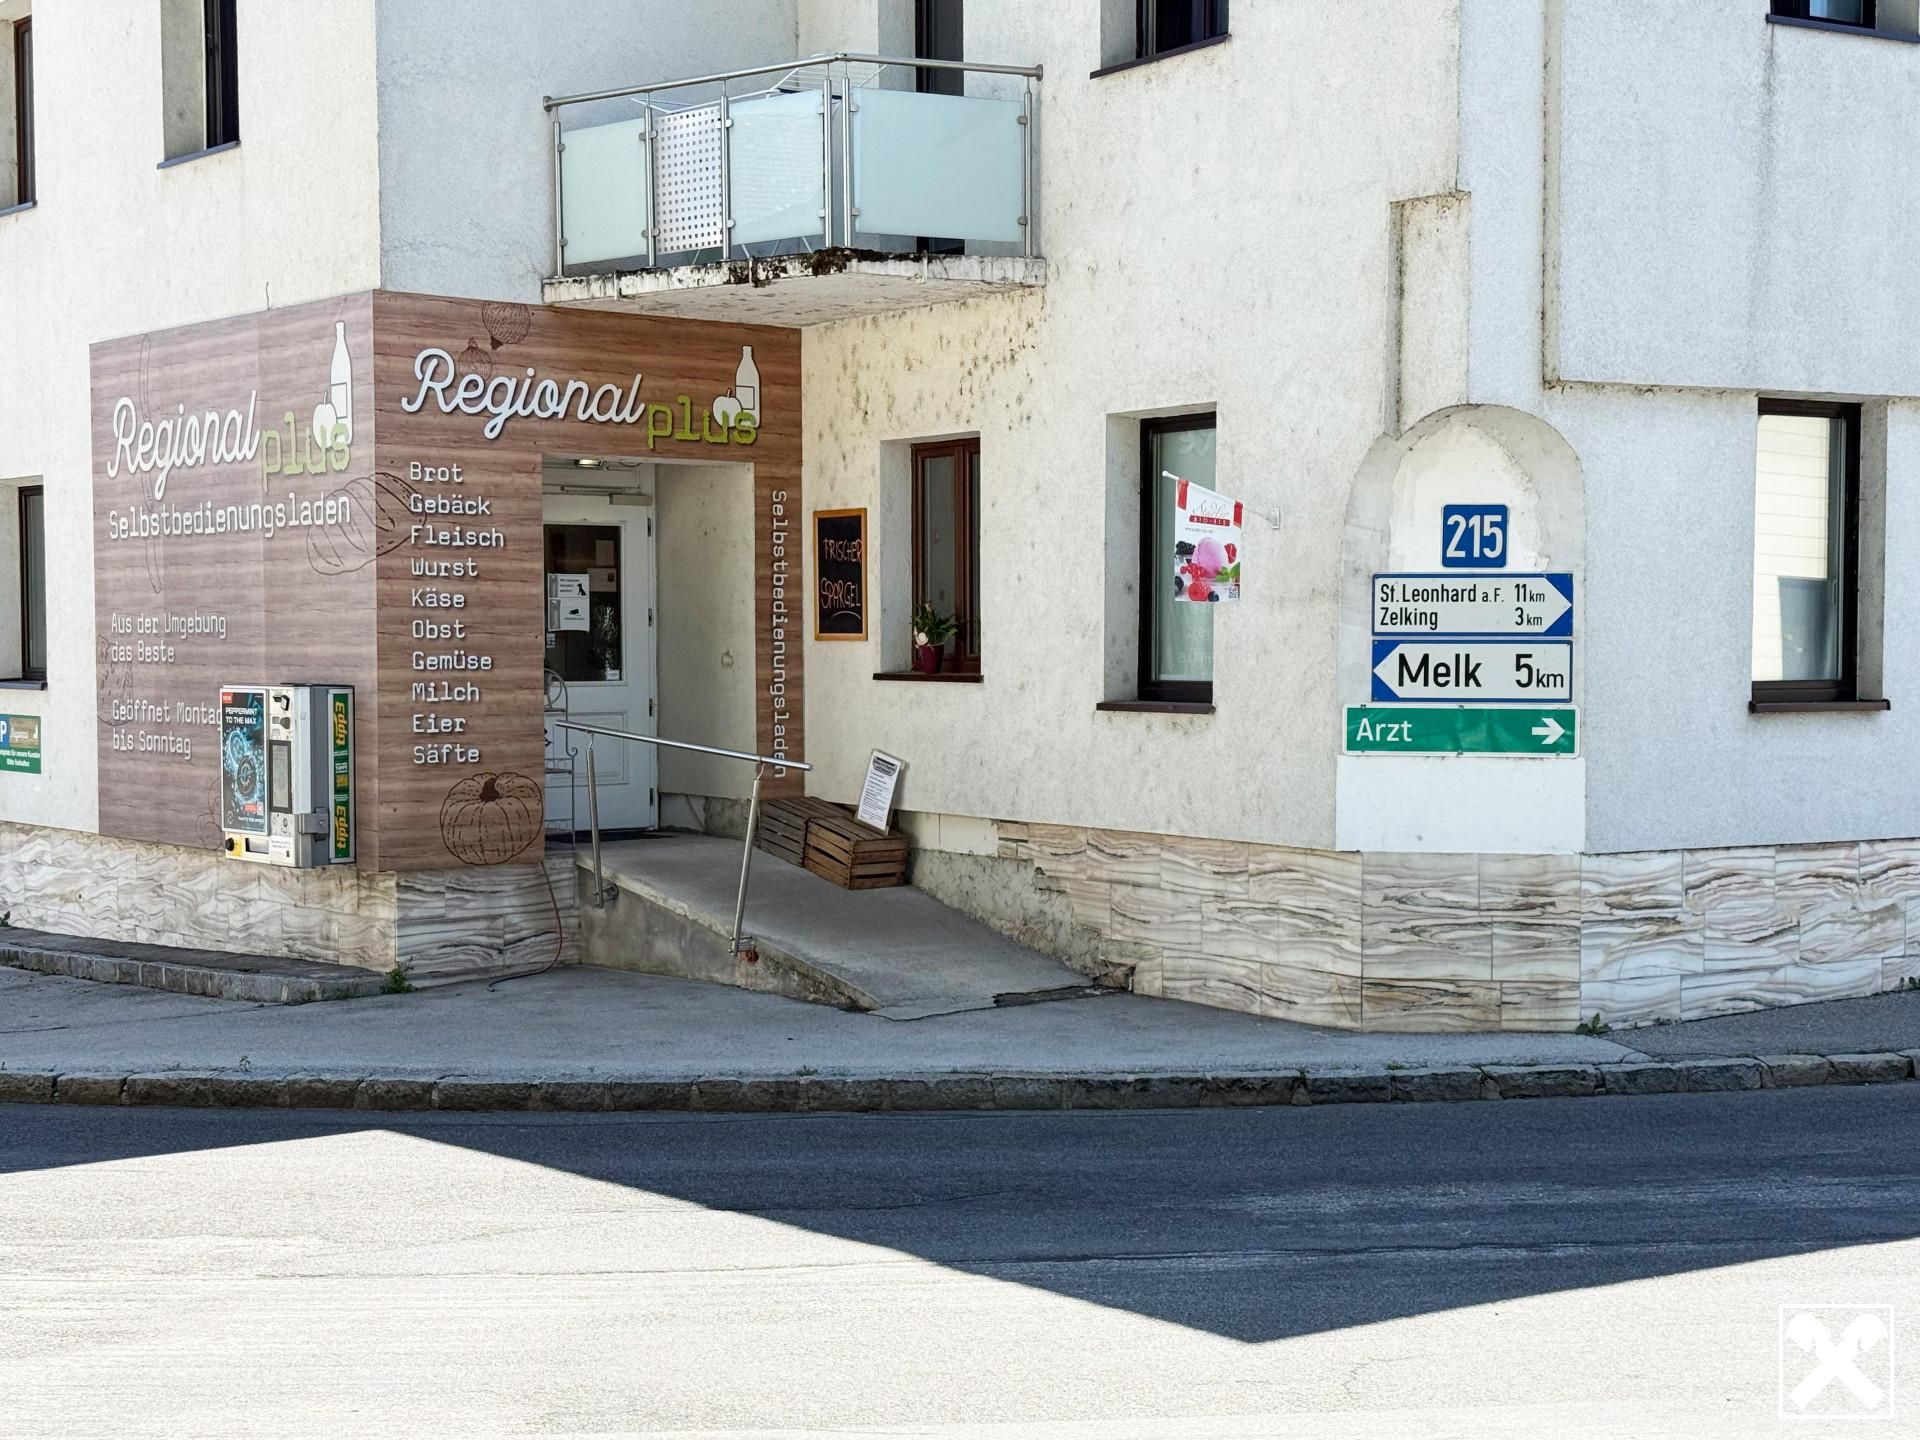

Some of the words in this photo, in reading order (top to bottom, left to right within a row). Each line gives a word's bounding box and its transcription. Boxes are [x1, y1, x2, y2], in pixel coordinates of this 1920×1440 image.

[401, 347, 647, 440] Regional
[646, 395, 760, 449] plus
[106, 390, 261, 501] Regional
[261, 411, 351, 494] plus
[410, 461, 463, 483] Brot
[109, 492, 351, 540] Selbstbedienungsladen
[410, 493, 491, 516] Gebäck
[410, 525, 505, 548] Fleisch
[1445, 514, 1504, 558] 215
[410, 556, 479, 577] Wurst
[411, 587, 465, 608] Käse
[821, 577, 861, 609] SPARGEL
[1529, 590, 1545, 602] km
[111, 612, 133, 633] Aus
[137, 611, 159, 634] der
[163, 609, 227, 639] Umgebung
[412, 619, 466, 639] Obst
[1380, 607, 1438, 631] Zelking
[1514, 607, 1525, 626] 3
[1526, 613, 1543, 626] km
[111, 640, 133, 662] das
[137, 640, 175, 663] Beste
[412, 650, 493, 670] Gemüse
[1398, 653, 1482, 688] Melk
[1515, 653, 1533, 688] 5
[1536, 669, 1564, 688] km
[412, 681, 480, 702] Milch
[112, 698, 171, 723] Geöffnet
[176, 700, 221, 732] Montag
[225, 716, 233, 724] TO
[233, 716, 244, 725] THE
[334, 701, 348, 746] tipp3
[413, 713, 467, 734] Eier
[1356, 718, 1413, 742] Arzt
[113, 728, 134, 751] bis
[139, 729, 192, 760] Sonntag
[413, 743, 481, 764] Säfte
[335, 805, 349, 849] tipp3
